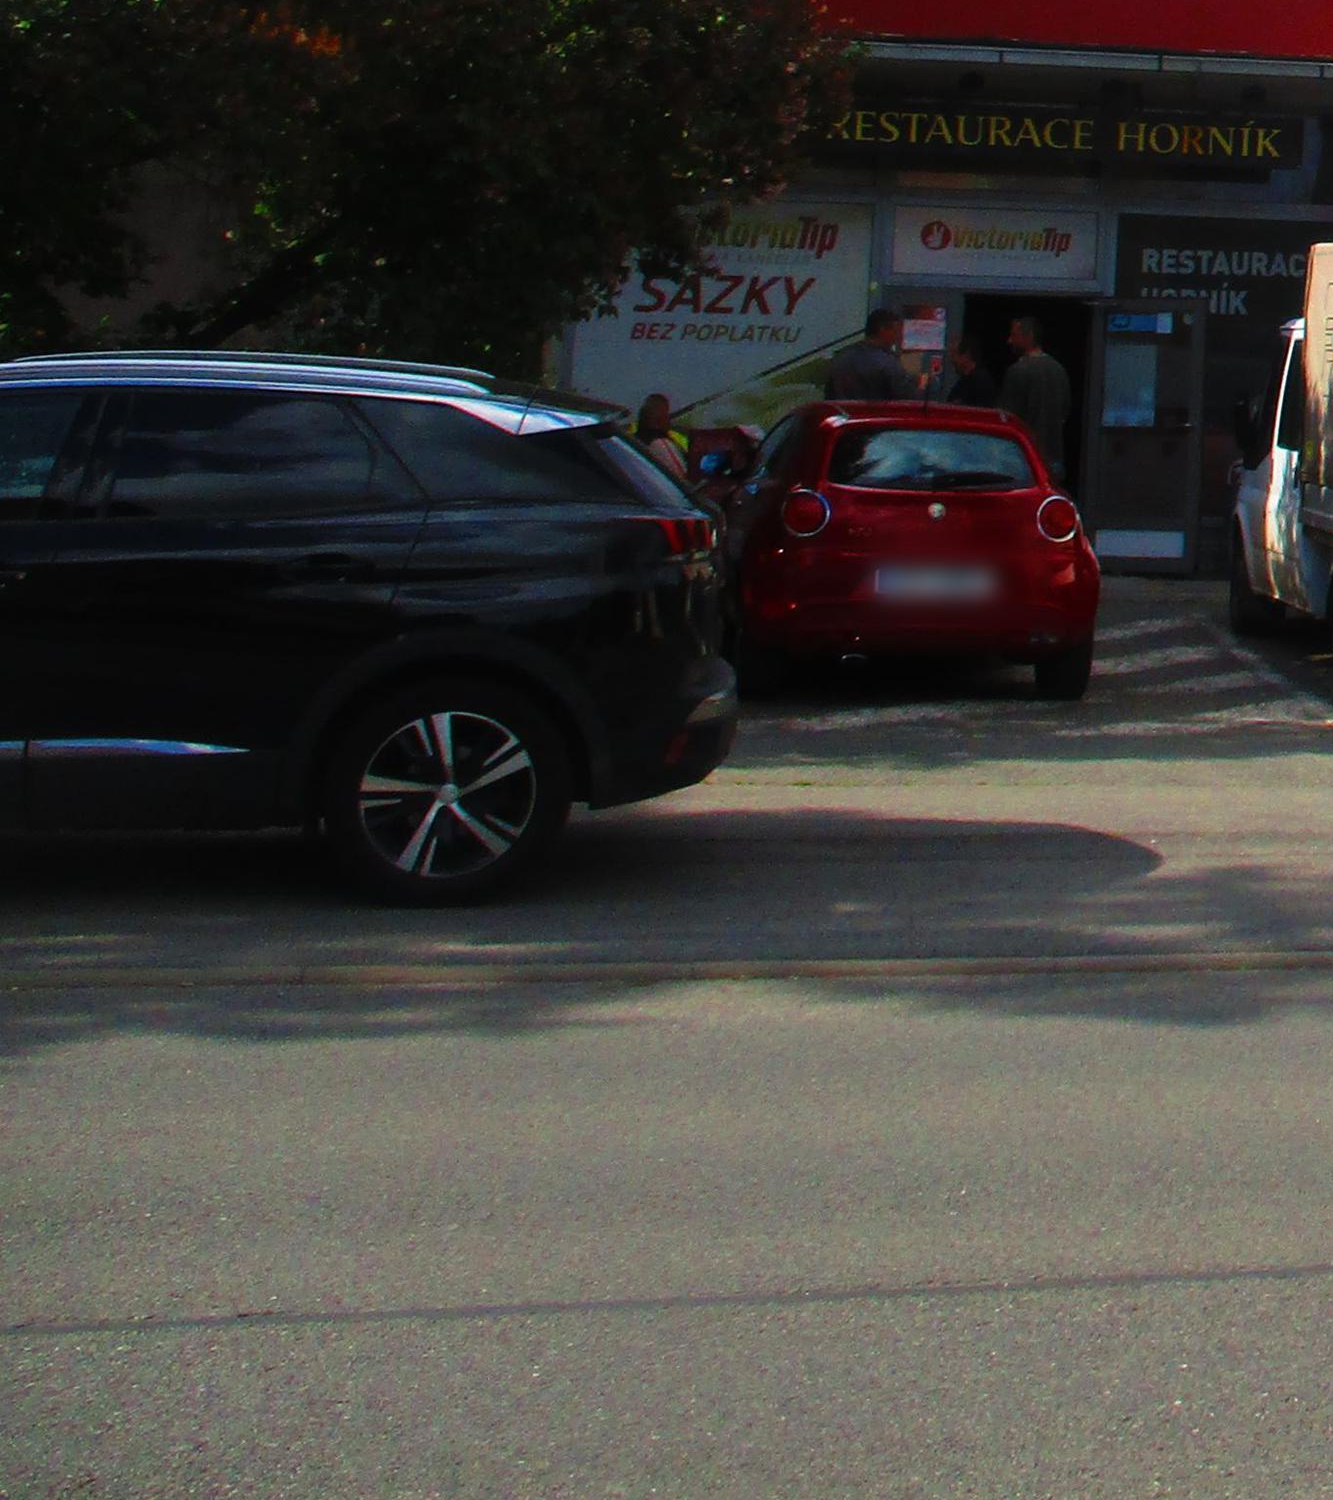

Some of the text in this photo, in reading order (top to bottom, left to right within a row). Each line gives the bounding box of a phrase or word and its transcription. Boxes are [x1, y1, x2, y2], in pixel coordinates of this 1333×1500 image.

[825, 110, 1281, 158] RESTAURACE HORNÍK
[1141, 247, 1306, 277] RESTAURAC
[630, 322, 802, 343] BEZ POPLATKU
